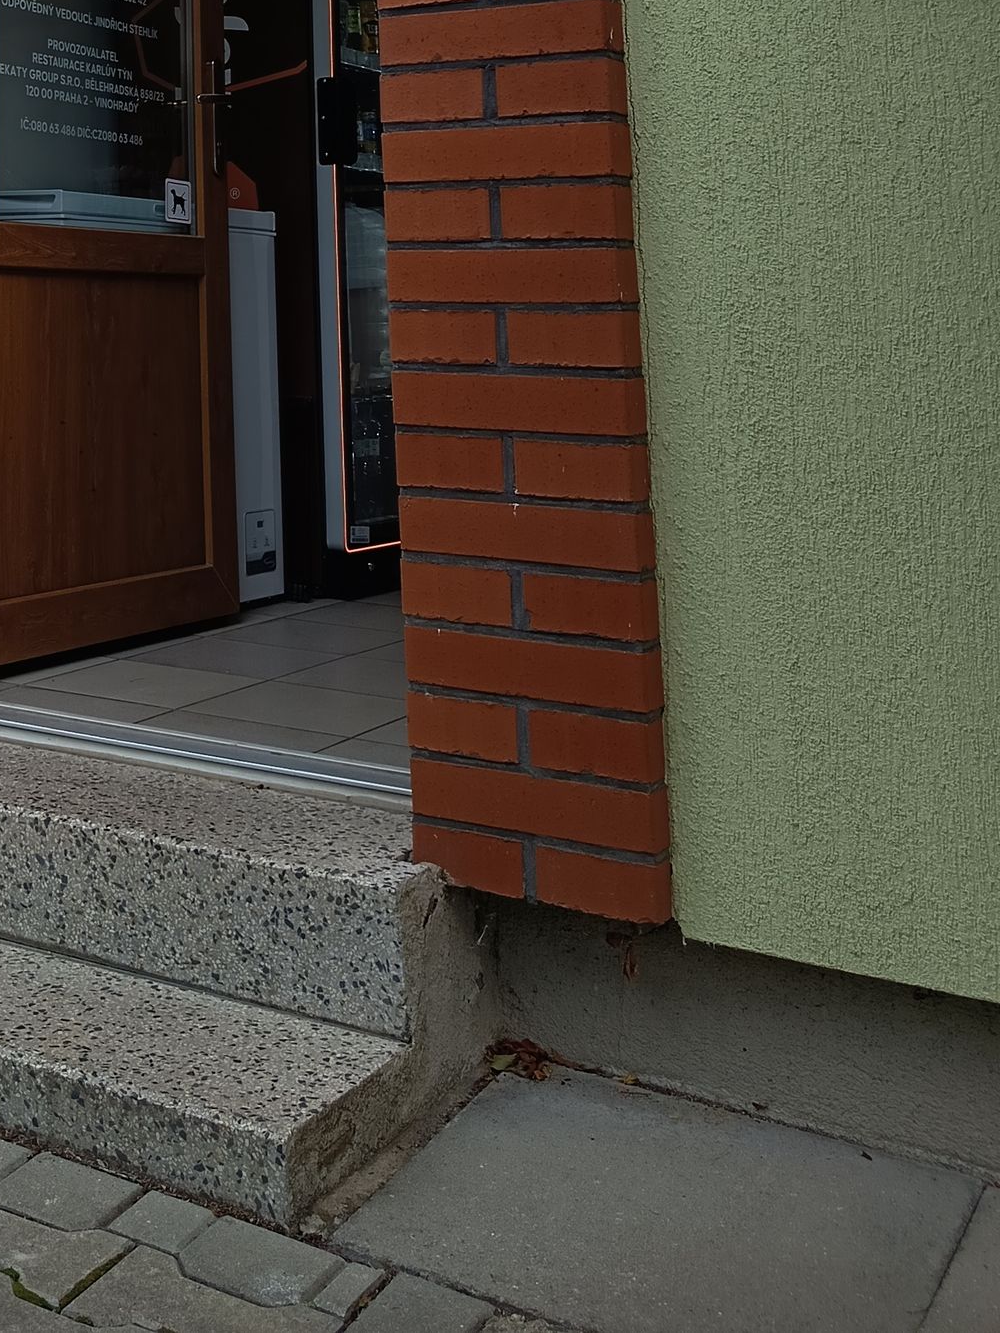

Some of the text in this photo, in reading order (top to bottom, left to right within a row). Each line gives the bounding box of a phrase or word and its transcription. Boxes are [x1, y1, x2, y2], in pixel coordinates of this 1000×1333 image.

[93, 16, 128, 33] JINDŘICH
[129, 23, 159, 39] STEHLÍK
[47, 38, 119, 62] PROVOZOVALATEL
[32, 52, 85, 72] RESTAURACE
[117, 67, 133, 81] TÝN
[25, 84, 40, 97] 120
[41, 88, 53, 99] 00
[54, 90, 82, 105] PRAHA
[29, 68, 59, 83] GROUP
[85, 77, 139, 97] BĚLEHRADSKÁ
[49, 122, 59, 134] 63
[60, 124, 76, 137] 486
[118, 133, 128, 144] 63
[129, 134, 143, 146] 486
